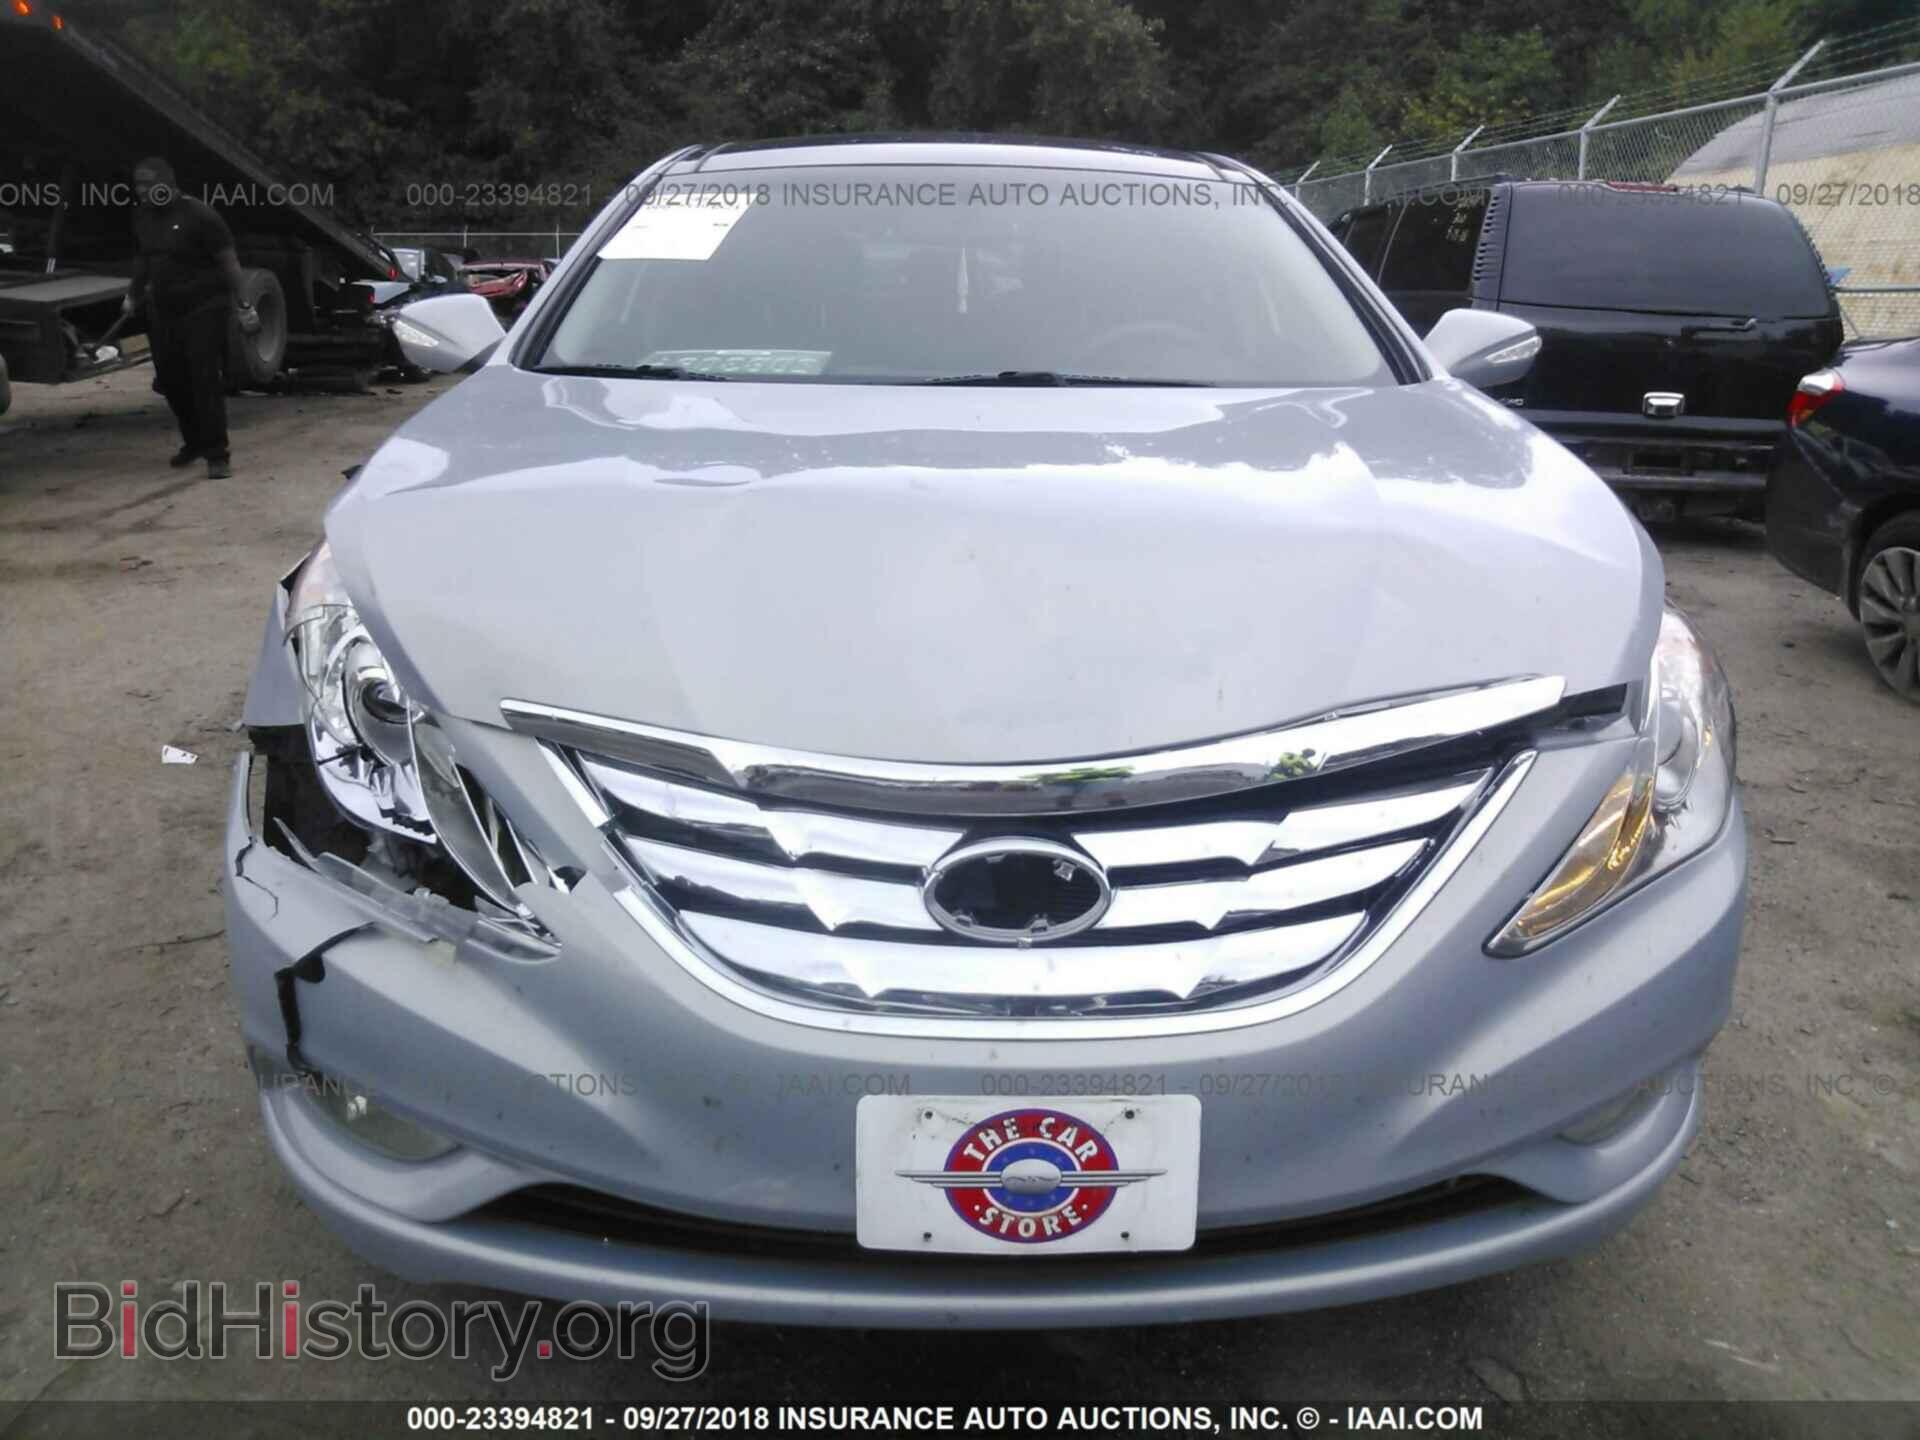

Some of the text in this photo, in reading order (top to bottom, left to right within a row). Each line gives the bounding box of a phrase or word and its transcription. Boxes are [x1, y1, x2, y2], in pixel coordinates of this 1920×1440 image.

[963, 1116, 1098, 1164] THE CAR
[979, 1204, 1082, 1238] STORE
